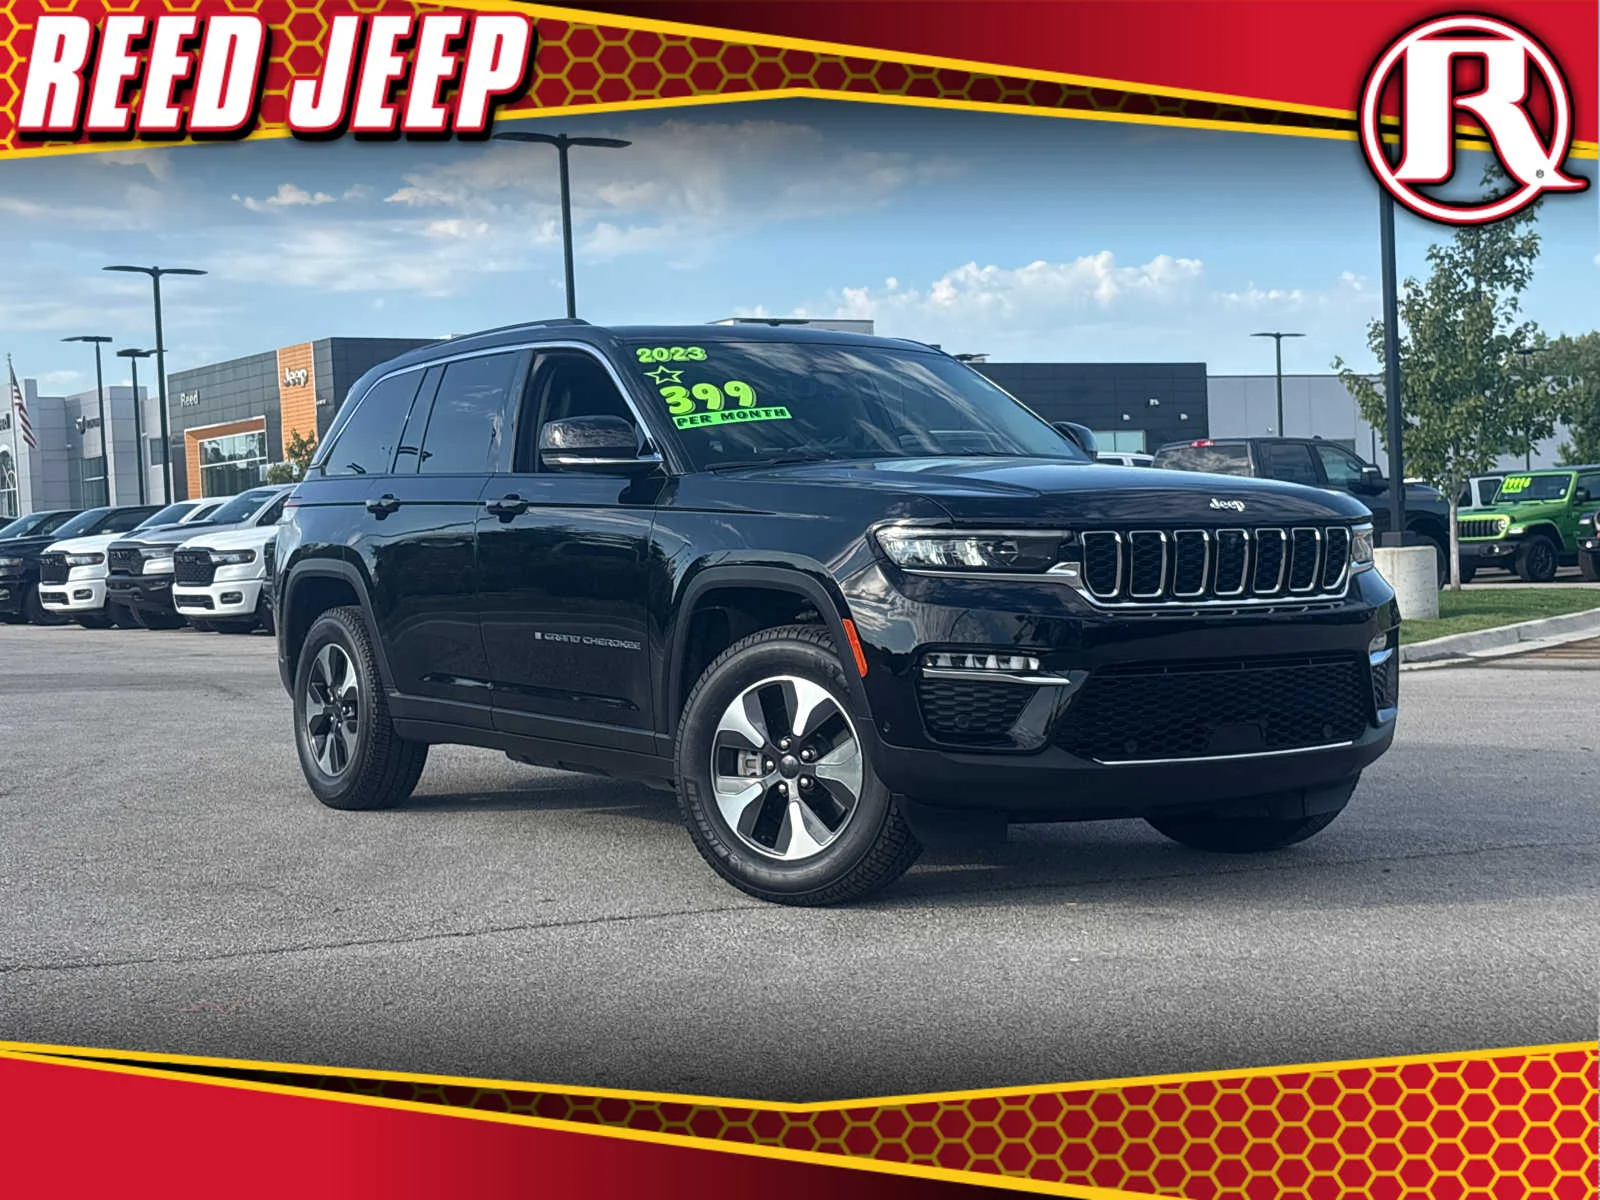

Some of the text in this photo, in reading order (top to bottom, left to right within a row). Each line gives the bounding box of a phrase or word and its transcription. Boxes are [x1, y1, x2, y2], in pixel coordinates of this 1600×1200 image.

[636, 346, 707, 363] 2023
[284, 367, 308, 387] Jeep
[180, 389, 199, 408] Reed
[660, 380, 756, 415] 399
[677, 407, 788, 427] PER MONTH
[1210, 498, 1245, 512] Jeep
[544, 632, 642, 650] GRAND CHEROKEE
[686, 781, 729, 858] MICHELIN
